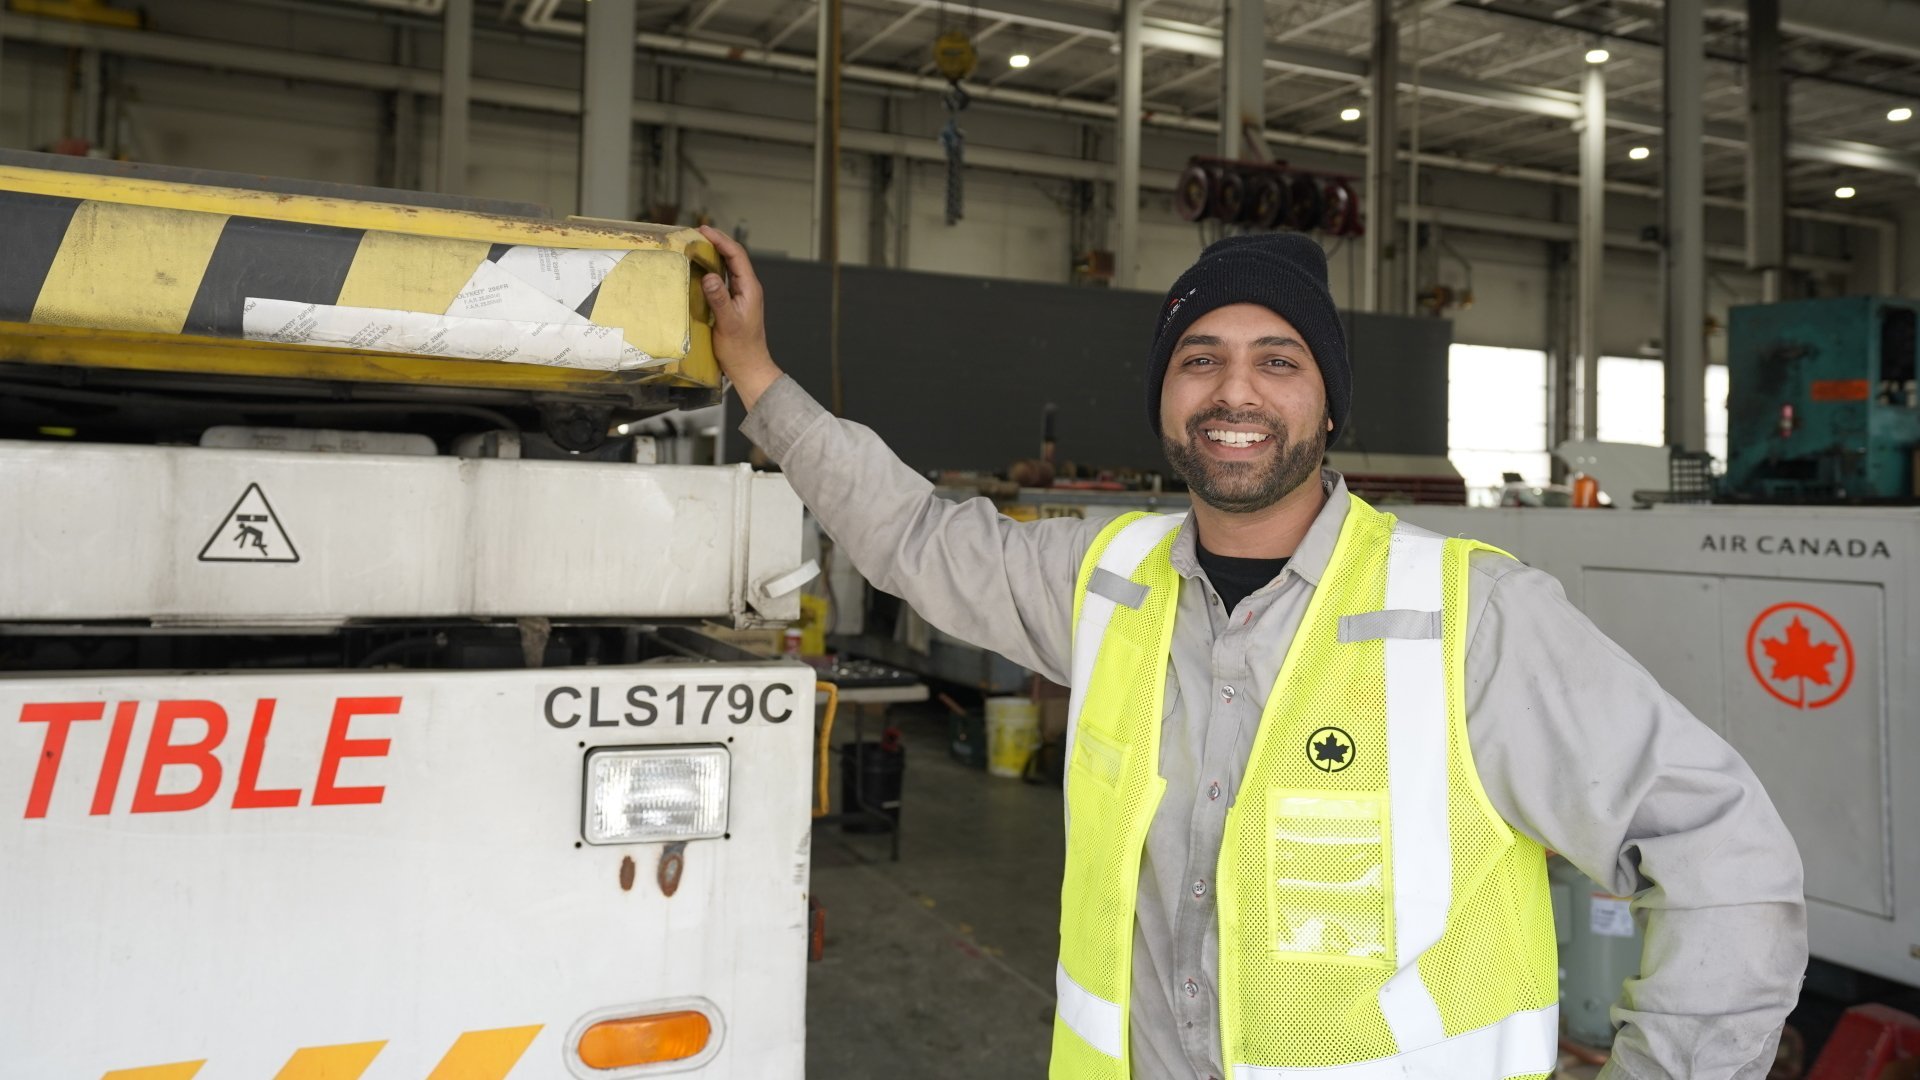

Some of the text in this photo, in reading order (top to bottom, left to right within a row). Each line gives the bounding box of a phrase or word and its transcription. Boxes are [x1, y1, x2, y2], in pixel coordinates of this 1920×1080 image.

[1701, 534, 1892, 559] AIR CANADA
[543, 682, 794, 730] CLS179C
[18, 695, 403, 819] TIBLE
